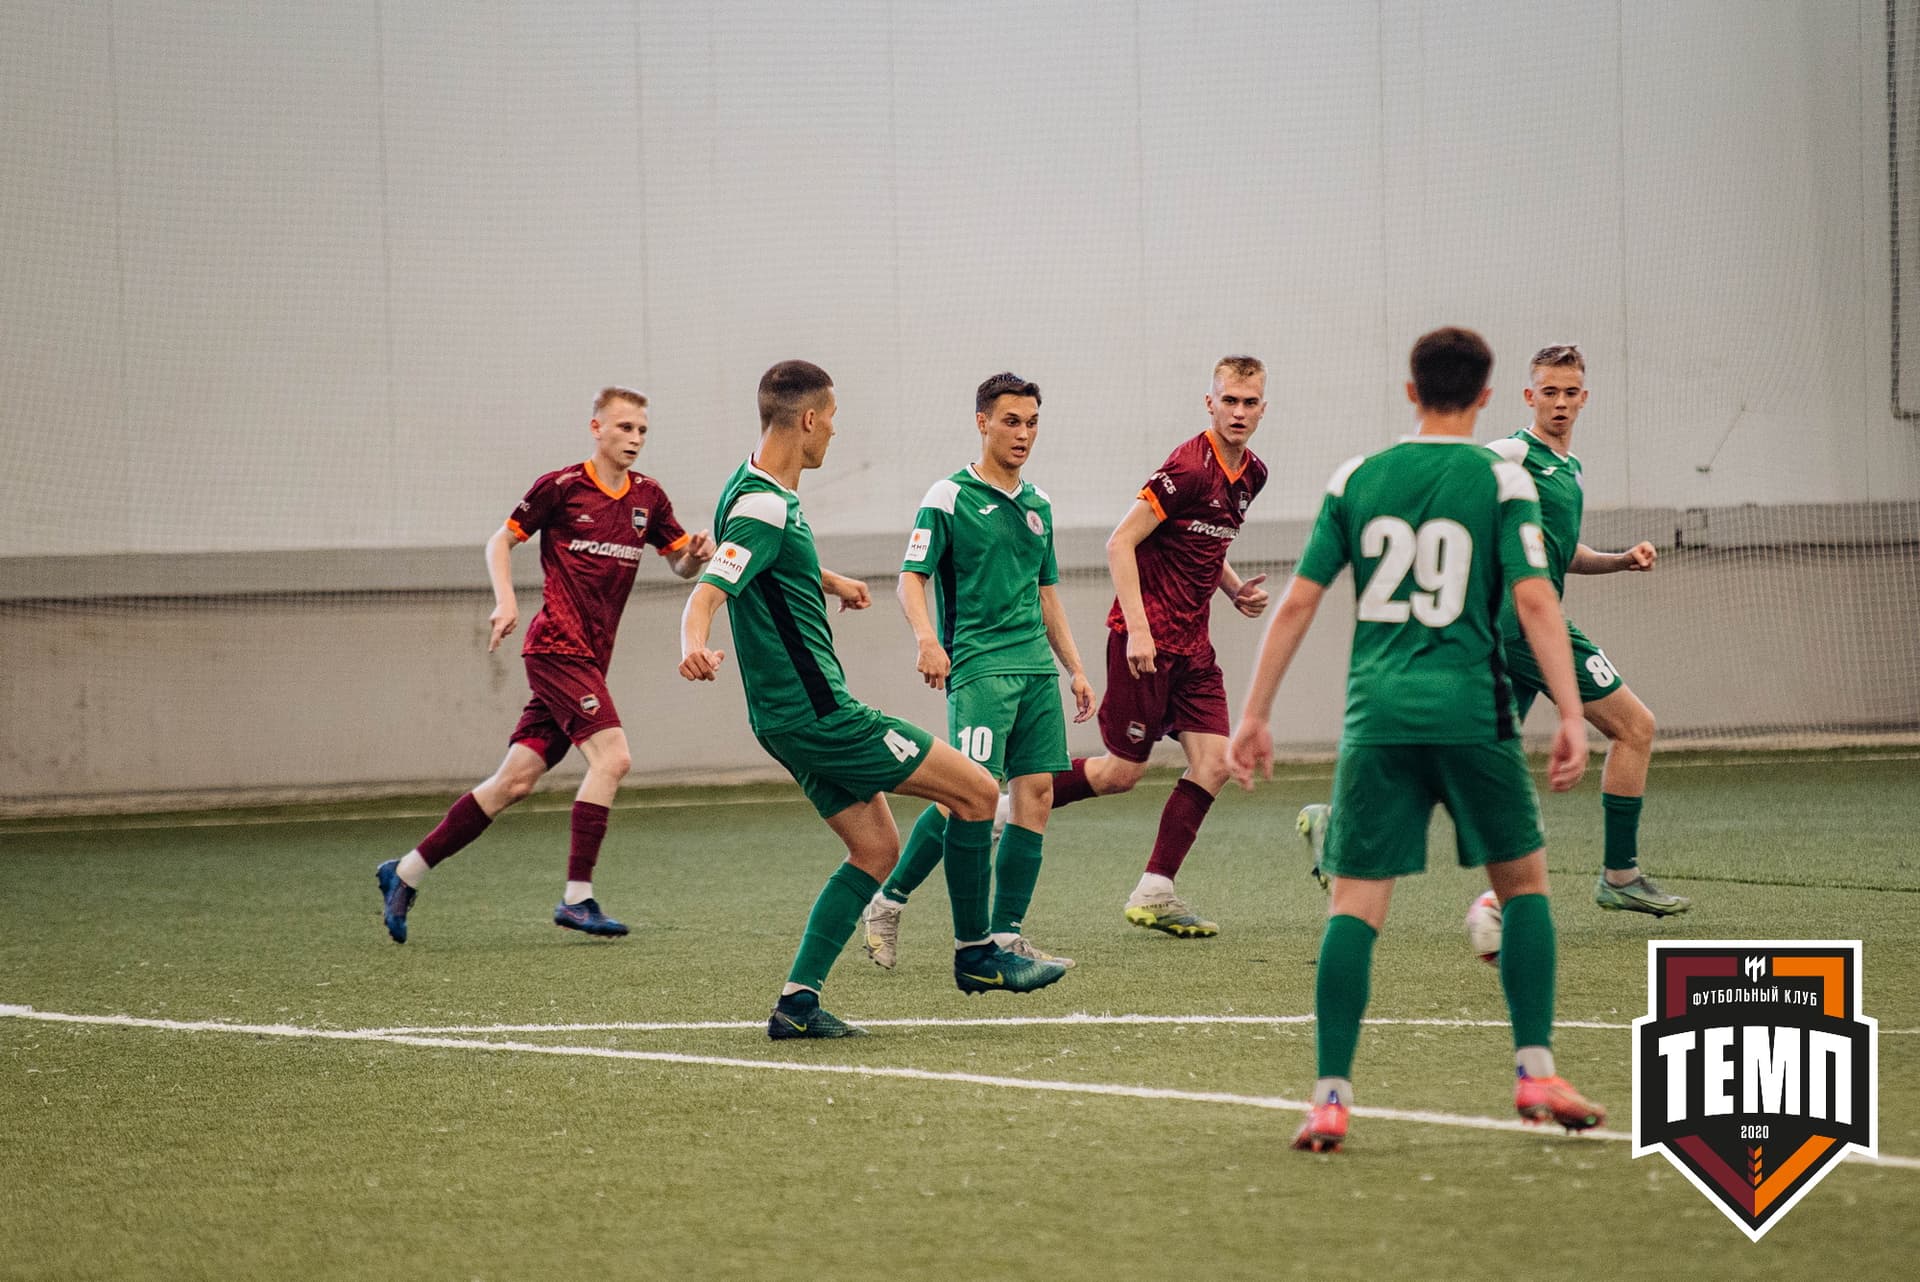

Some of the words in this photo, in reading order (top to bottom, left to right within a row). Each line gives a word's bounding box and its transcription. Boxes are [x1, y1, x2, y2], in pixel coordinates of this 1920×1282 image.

[1358, 515, 1473, 628] 29
[883, 728, 921, 763] 4
[957, 726, 993, 762] 10
